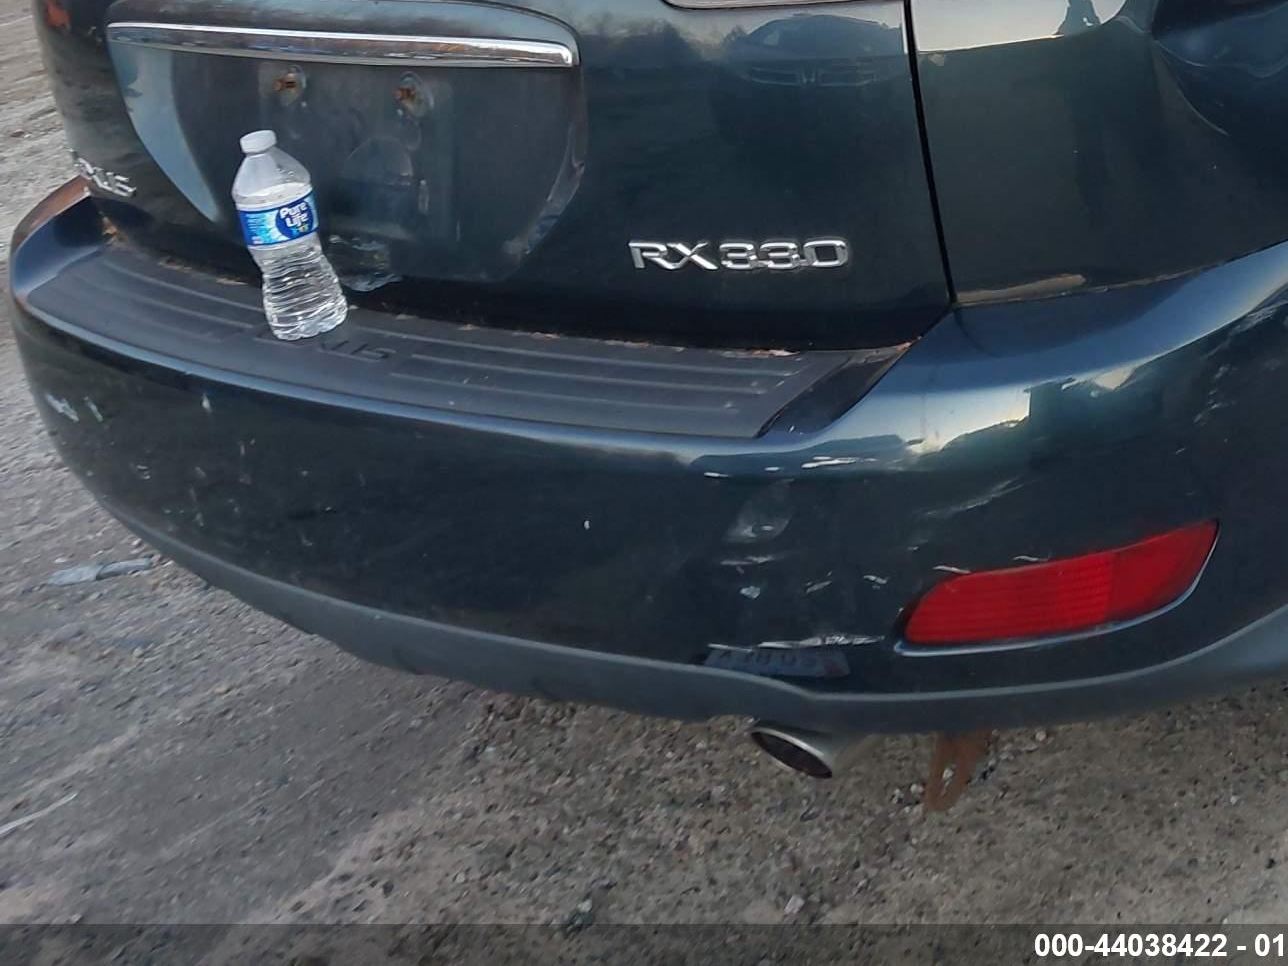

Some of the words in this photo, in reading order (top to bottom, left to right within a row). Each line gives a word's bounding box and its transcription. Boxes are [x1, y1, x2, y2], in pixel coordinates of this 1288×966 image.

[279, 200, 308, 219] Pure
[284, 211, 309, 228] Life
[627, 237, 850, 270] RX330
